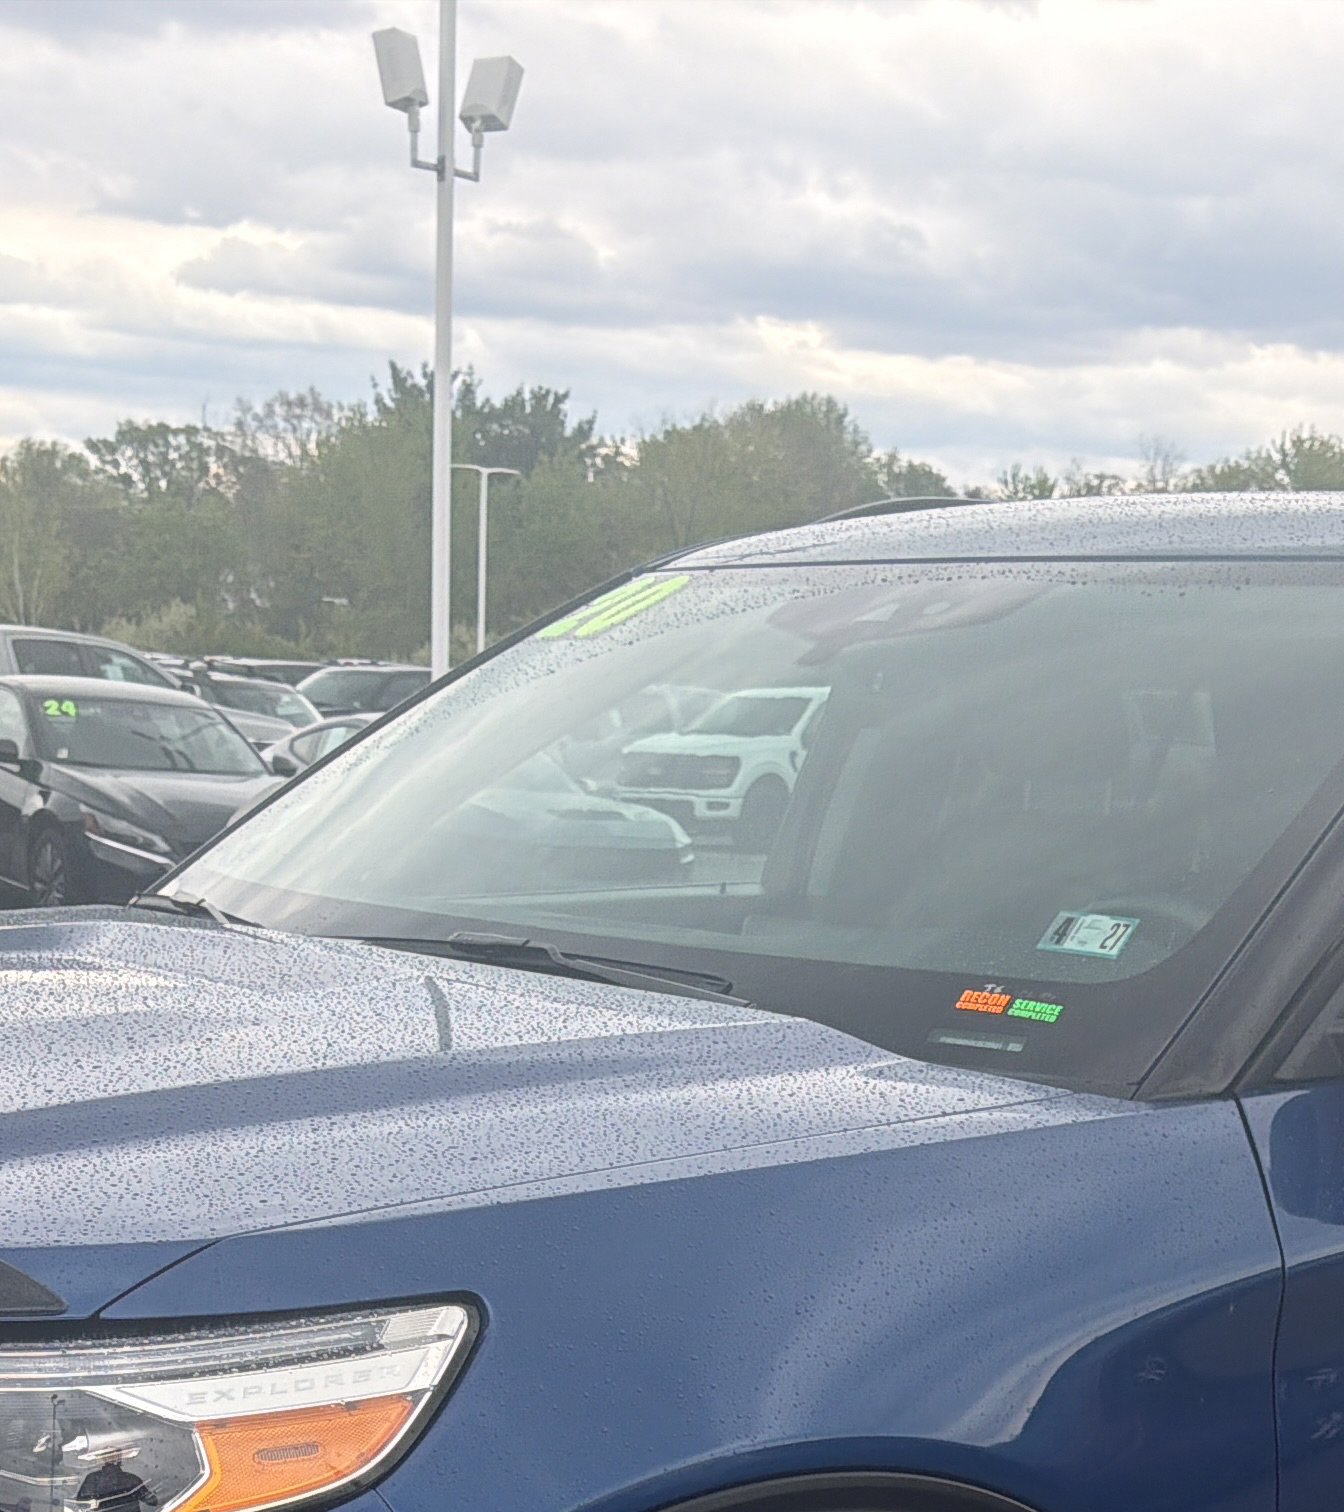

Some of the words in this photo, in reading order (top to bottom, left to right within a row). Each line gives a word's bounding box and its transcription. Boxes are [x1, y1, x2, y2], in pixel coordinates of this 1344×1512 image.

[42, 699, 77, 717] 24
[1052, 916, 1075, 946] 4
[1099, 922, 1131, 952] 27
[959, 989, 1012, 1007] RECON
[1012, 998, 1064, 1016] SERVICE
[1006, 1008, 1057, 1023] COMPLETED
[186, 1364, 402, 1406] EXPLORER
